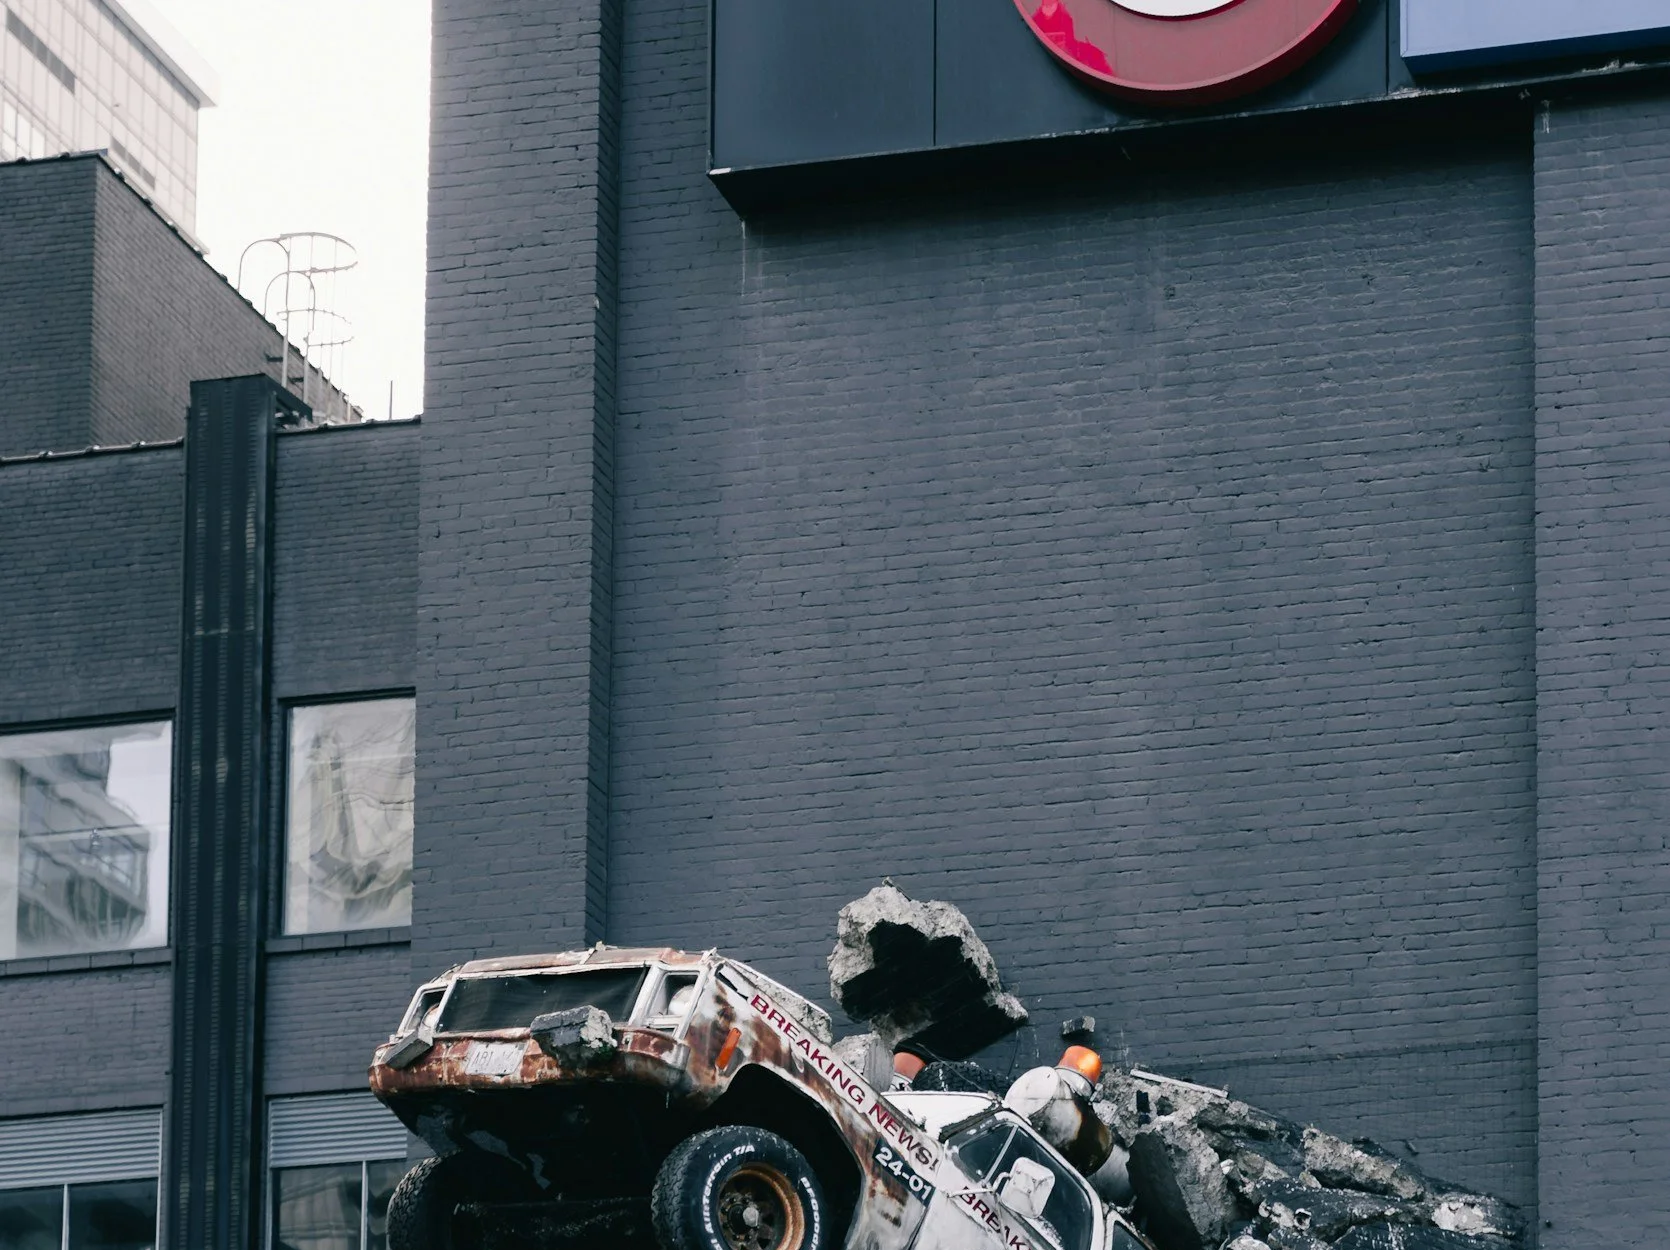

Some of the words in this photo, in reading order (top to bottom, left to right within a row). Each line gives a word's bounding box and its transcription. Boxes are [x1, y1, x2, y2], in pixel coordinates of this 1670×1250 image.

[751, 994, 865, 1105] BREAKING
[867, 1102, 940, 1171] NEWS!
[733, 1144, 755, 1156] T/A
[875, 1146, 933, 1199] 24-01
